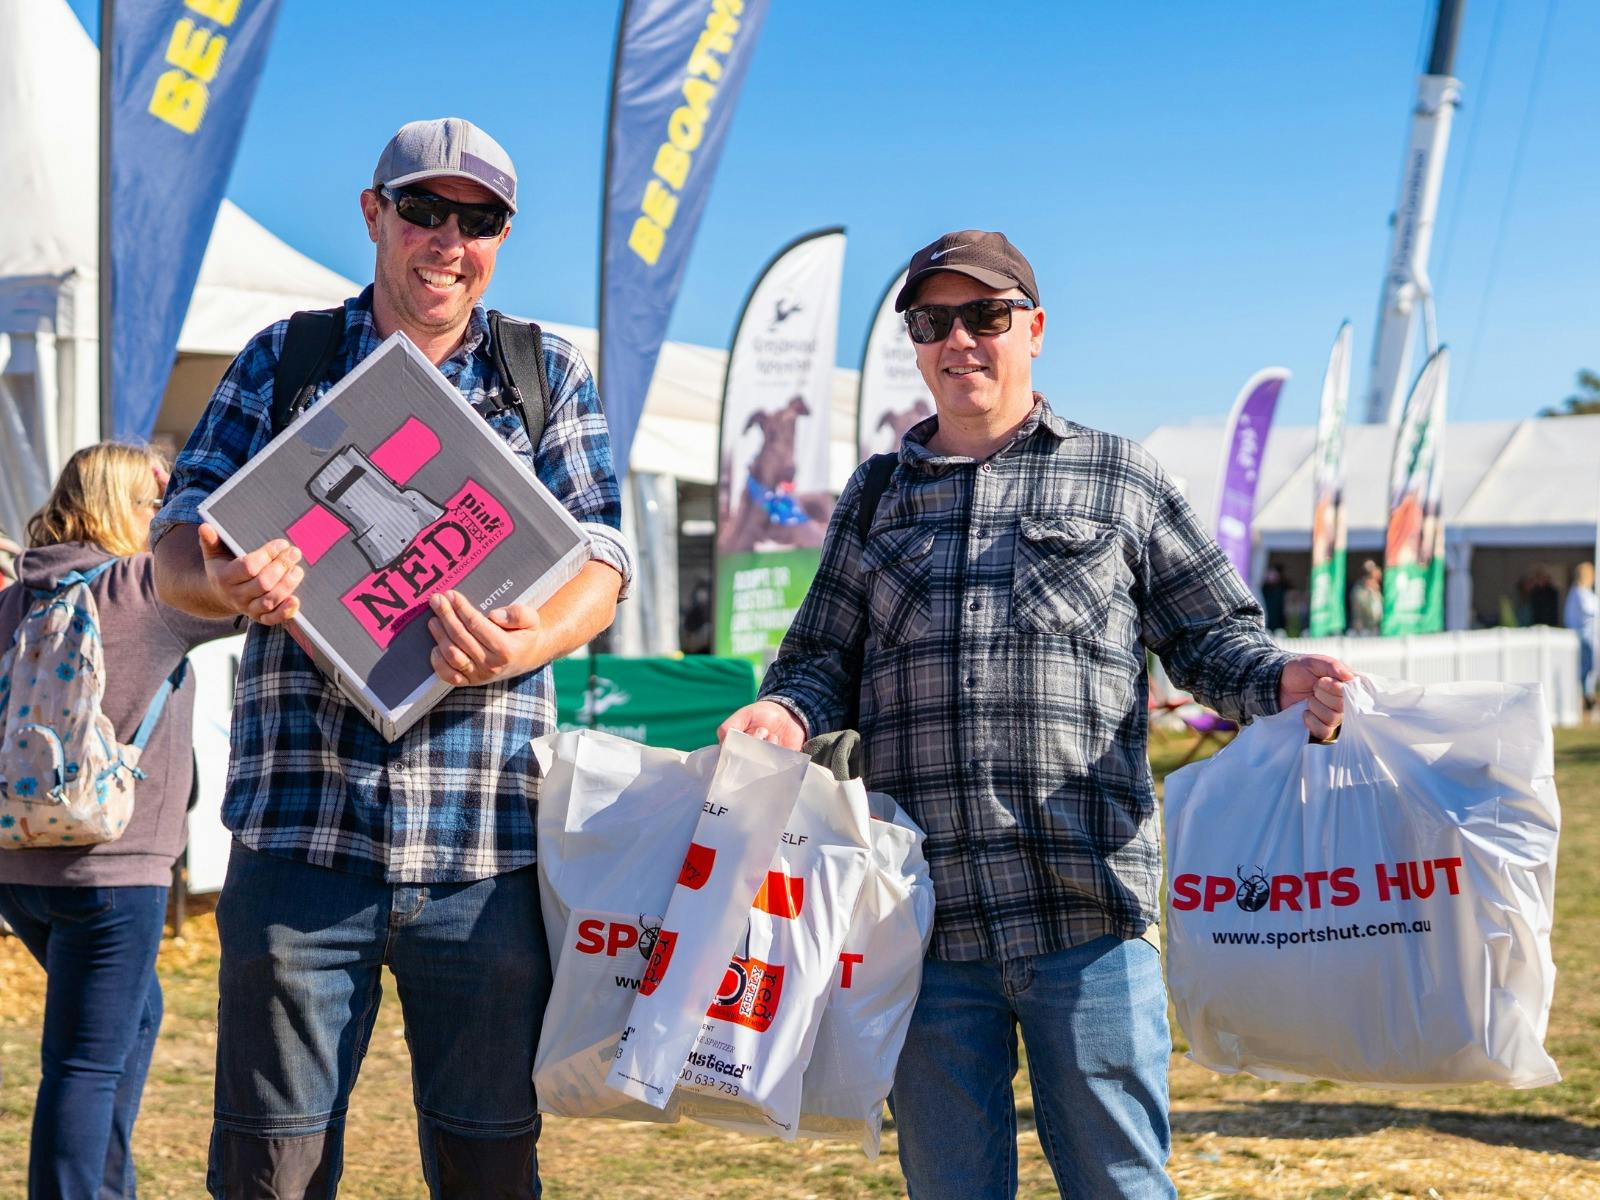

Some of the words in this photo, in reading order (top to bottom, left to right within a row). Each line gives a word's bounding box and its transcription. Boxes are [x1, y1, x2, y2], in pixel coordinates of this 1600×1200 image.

[147, 17, 228, 134] BE
[628, 178, 679, 266] BE
[450, 504, 488, 543] KELLY
[459, 492, 502, 534] pink
[352, 520, 472, 631] NED
[479, 578, 515, 611] BOTTLES
[1374, 857, 1463, 902] HUT
[1211, 918, 1432, 949] www.sportshut.com.au
[694, 1074, 715, 1088] 633
[719, 1080, 740, 1097] 733
